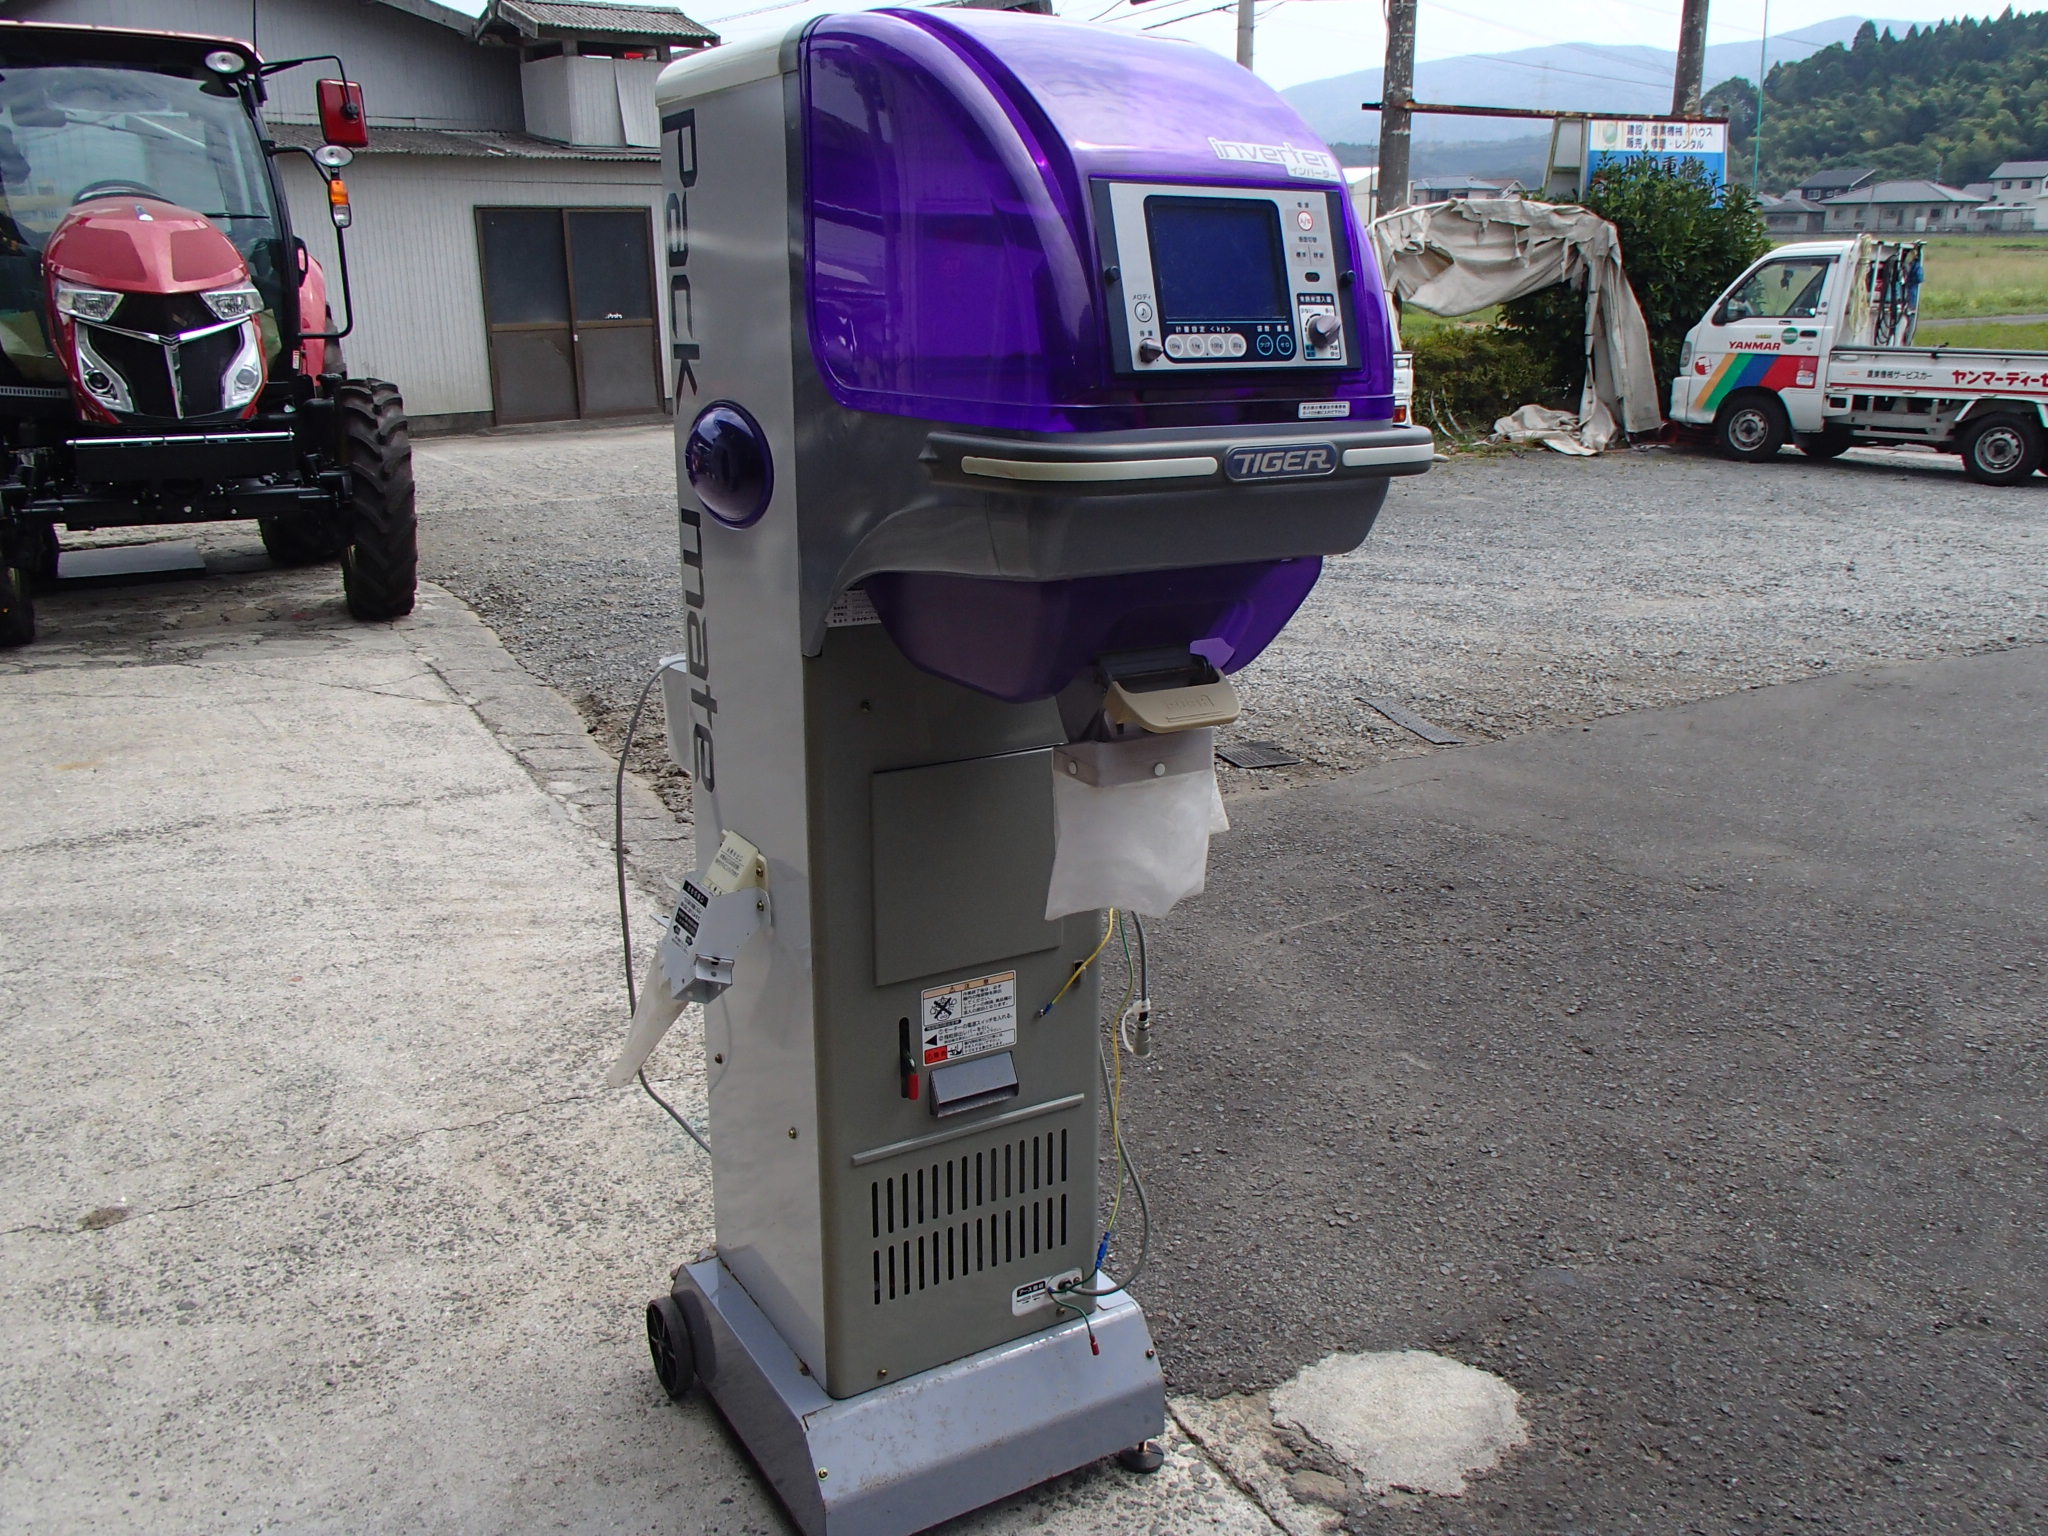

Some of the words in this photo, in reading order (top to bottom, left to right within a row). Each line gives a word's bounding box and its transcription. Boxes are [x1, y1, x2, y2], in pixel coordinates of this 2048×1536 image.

[1729, 341, 1781, 351] YANMAR
[1233, 449, 1331, 475] TIGER
[680, 507, 718, 794] mate
